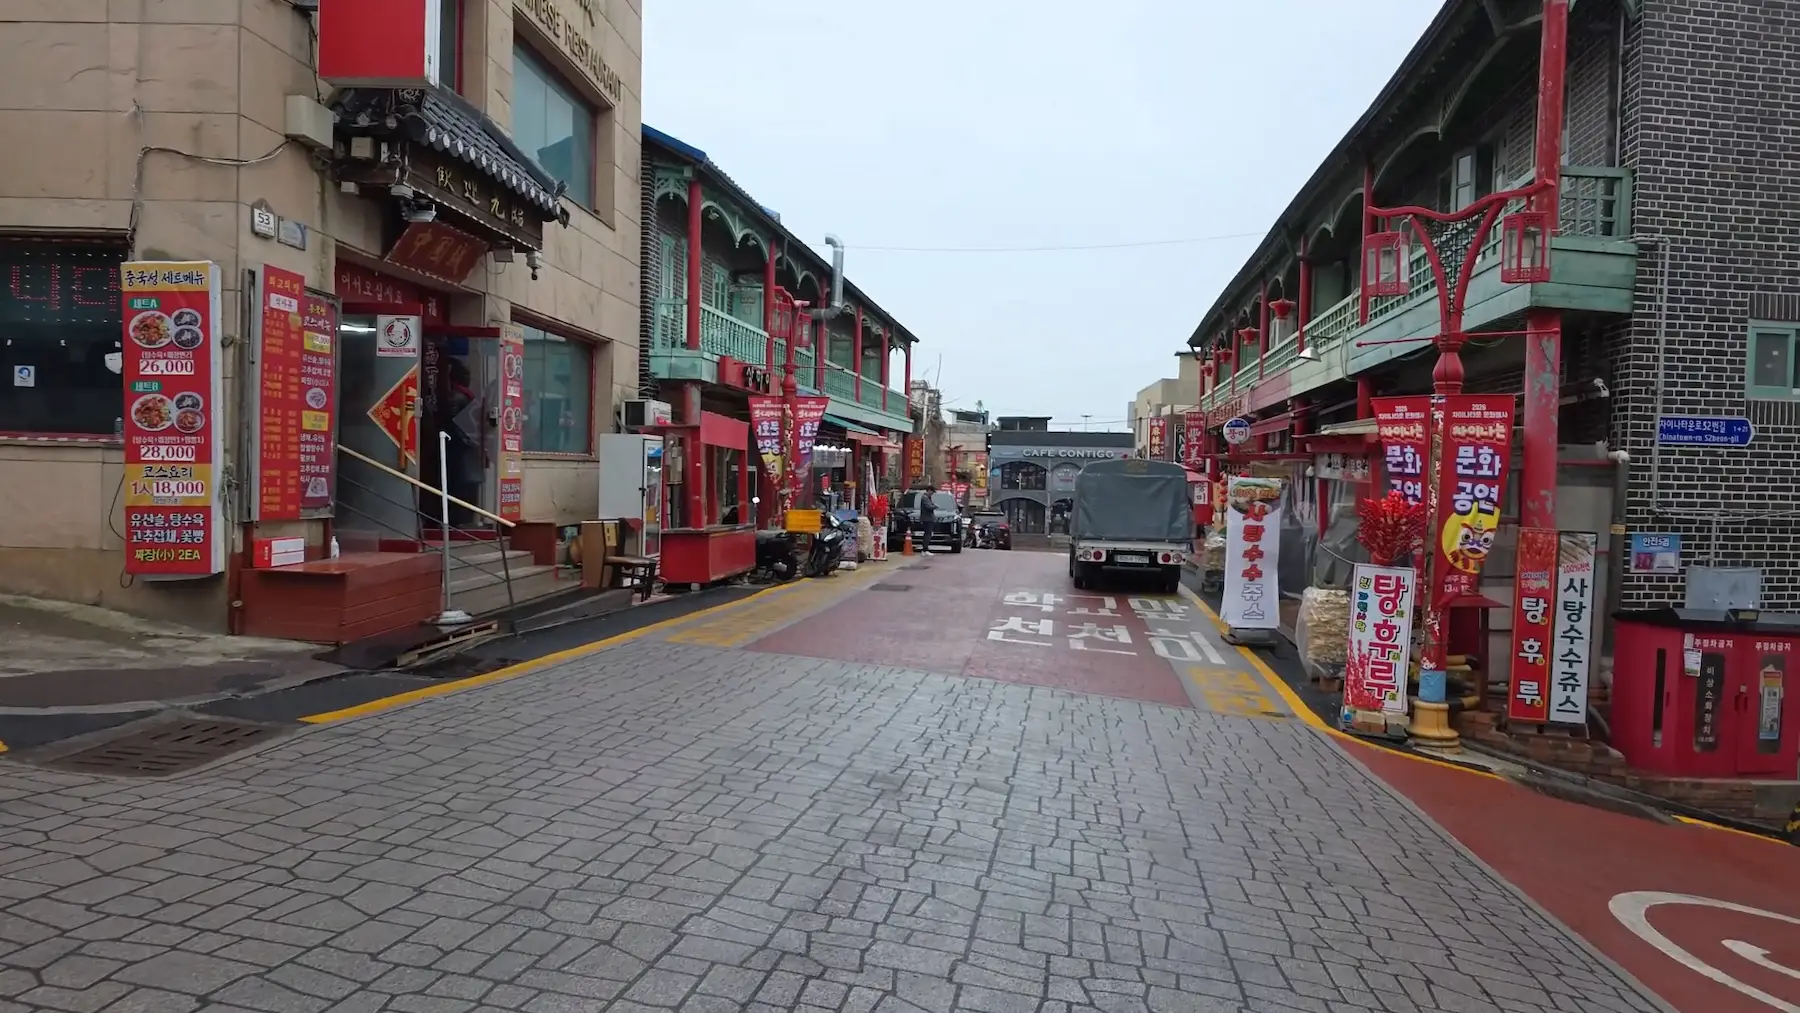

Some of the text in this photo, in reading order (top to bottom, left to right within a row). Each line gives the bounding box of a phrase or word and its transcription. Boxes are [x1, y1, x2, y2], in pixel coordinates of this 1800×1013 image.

[565, 20, 621, 101] RESTAURANT
[258, 212, 270, 225] 53
[125, 270, 205, 287] 중국성 세트메뉴
[132, 299, 157, 309] 세트A
[140, 360, 193, 374] 26,000
[135, 382, 159, 391] 세트B
[1226, 428, 1247, 440] 풍미
[141, 446, 194, 459] 28,000
[1023, 448, 1114, 458] CAFE CONTIGO
[1386, 445, 1422, 474] 문화
[1455, 445, 1501, 476] 문화
[142, 466, 193, 479] 코스요리
[131, 481, 205, 496] 1人 18,000
[1453, 481, 1500, 512] 공연
[131, 513, 204, 527] 유산슬,탕수육
[131, 530, 204, 544] 고추잡채,꽃빵
[135, 549, 201, 562] 짜장(小) 2EA
[987, 617, 1227, 665] 천천히
[1364, 575, 1406, 698] 탕후루
[1694, 639, 1733, 648] 주정차금지
[1516, 597, 1547, 705] 탕후루
[1556, 577, 1589, 715] 사탕수수쥬스
[1755, 642, 1791, 651] 주정차금지
[1703, 667, 1715, 735] 비상소화장치
